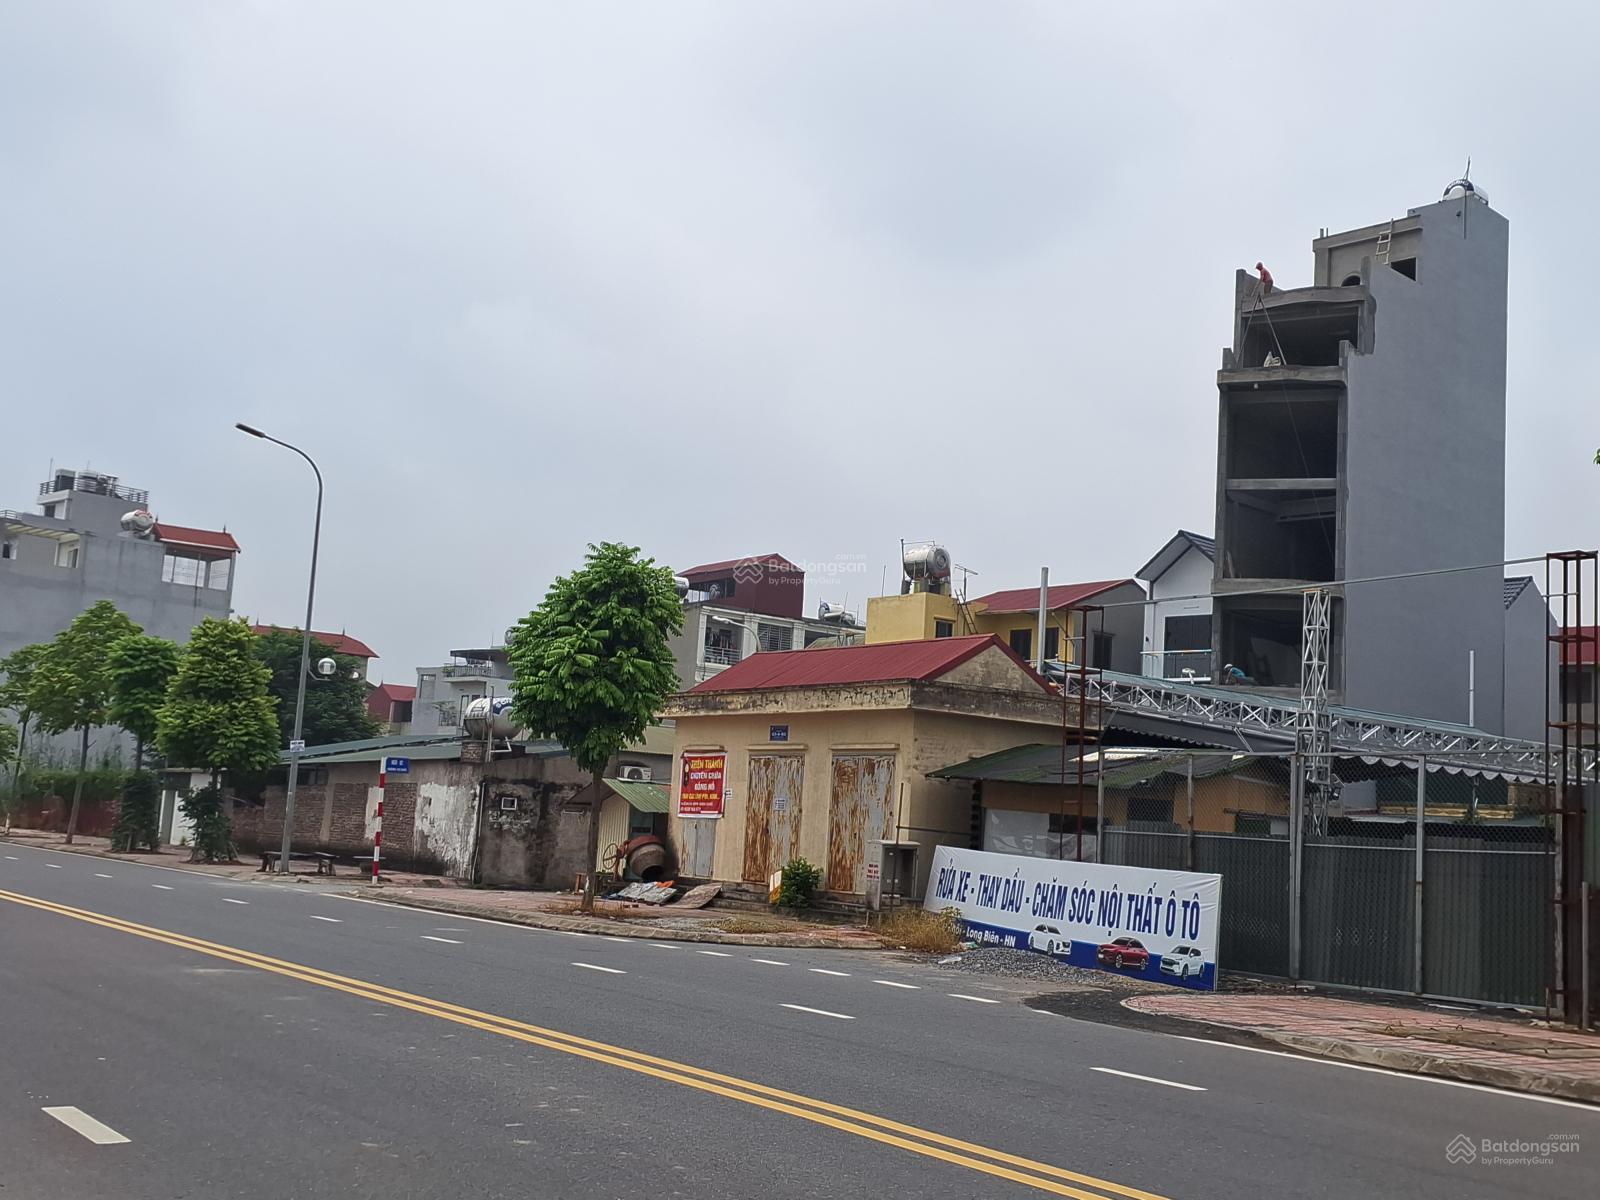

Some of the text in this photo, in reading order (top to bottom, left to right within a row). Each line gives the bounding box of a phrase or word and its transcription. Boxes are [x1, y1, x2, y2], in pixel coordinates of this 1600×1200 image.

[935, 857, 957, 900] RỬA
[954, 870, 972, 903] XE
[975, 873, 1003, 910] THAY
[1031, 876, 1069, 921] CHĂM
[1068, 880, 1096, 925] SÓC
[1097, 883, 1123, 937] NỘI
[1125, 882, 1163, 935] THẤT
[1165, 890, 1177, 937] Ô
[1181, 892, 1200, 941] TÔ
[966, 926, 983, 943] Long
[983, 930, 1000, 945] Biên
[1003, 934, 1016, 948] HN
